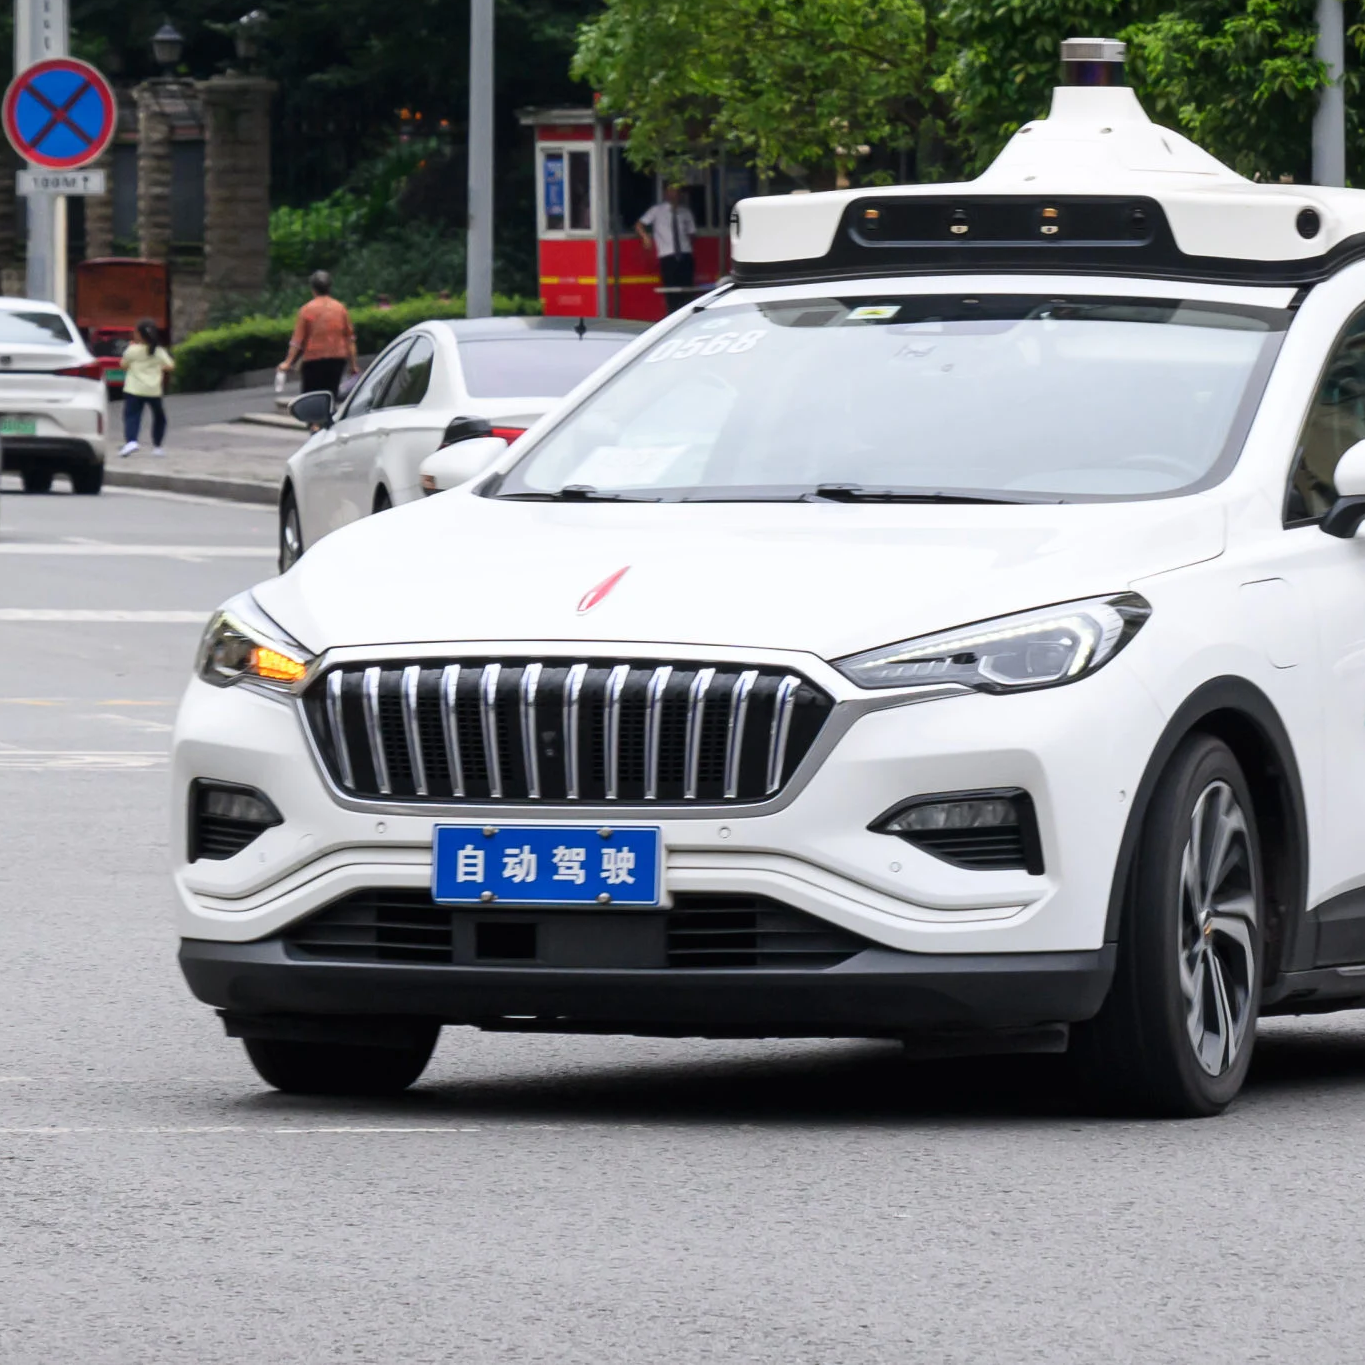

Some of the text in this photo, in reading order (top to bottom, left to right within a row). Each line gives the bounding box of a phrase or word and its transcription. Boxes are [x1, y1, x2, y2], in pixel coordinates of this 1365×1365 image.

[644, 329, 768, 364] 0568
[454, 843, 637, 887] 自动驾驶
